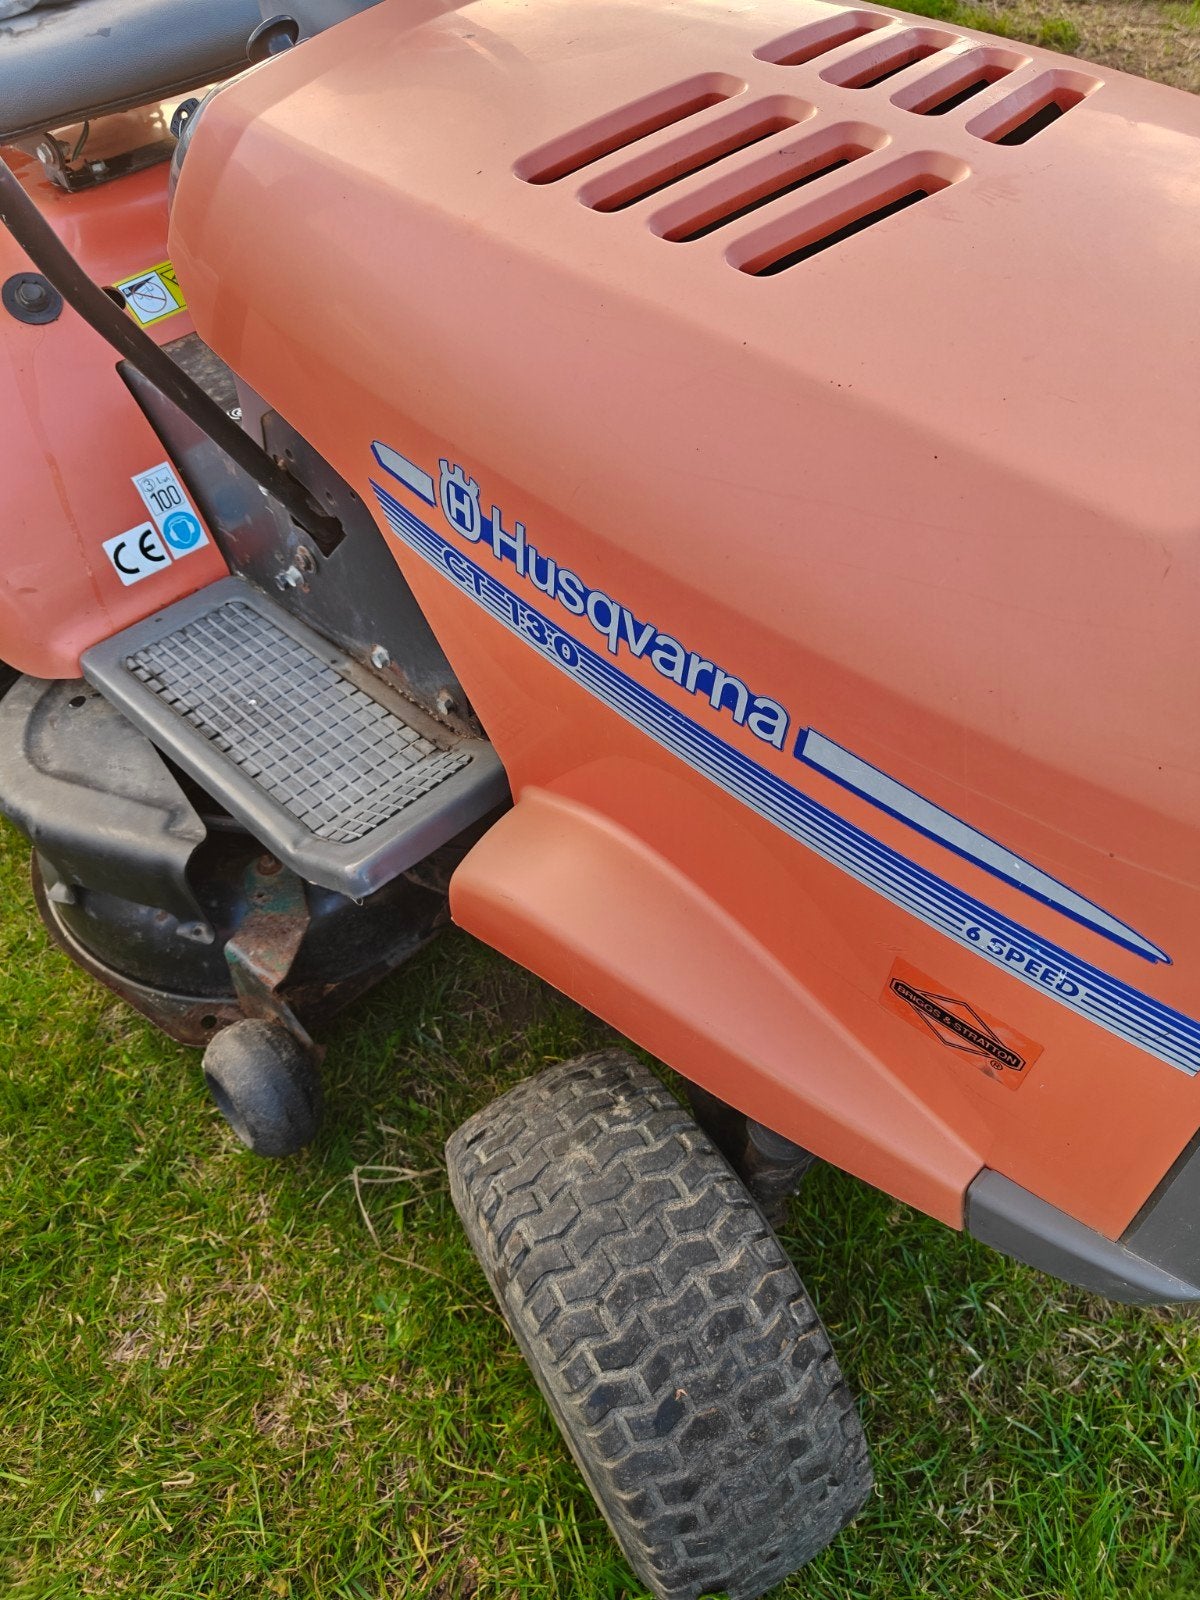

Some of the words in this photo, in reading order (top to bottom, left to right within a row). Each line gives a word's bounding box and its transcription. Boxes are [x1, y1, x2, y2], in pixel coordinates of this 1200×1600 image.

[150, 485, 182, 512] 100
[113, 529, 166, 575] CE
[491, 505, 791, 751] Husqvarna
[505, 594, 579, 668] 130
[965, 926, 981, 942] 6
[986, 937, 1080, 997] SPEED
[897, 985, 942, 1019] BRIGGS
[942, 1015, 952, 1025] &
[953, 1022, 1018, 1065] STRATTON
